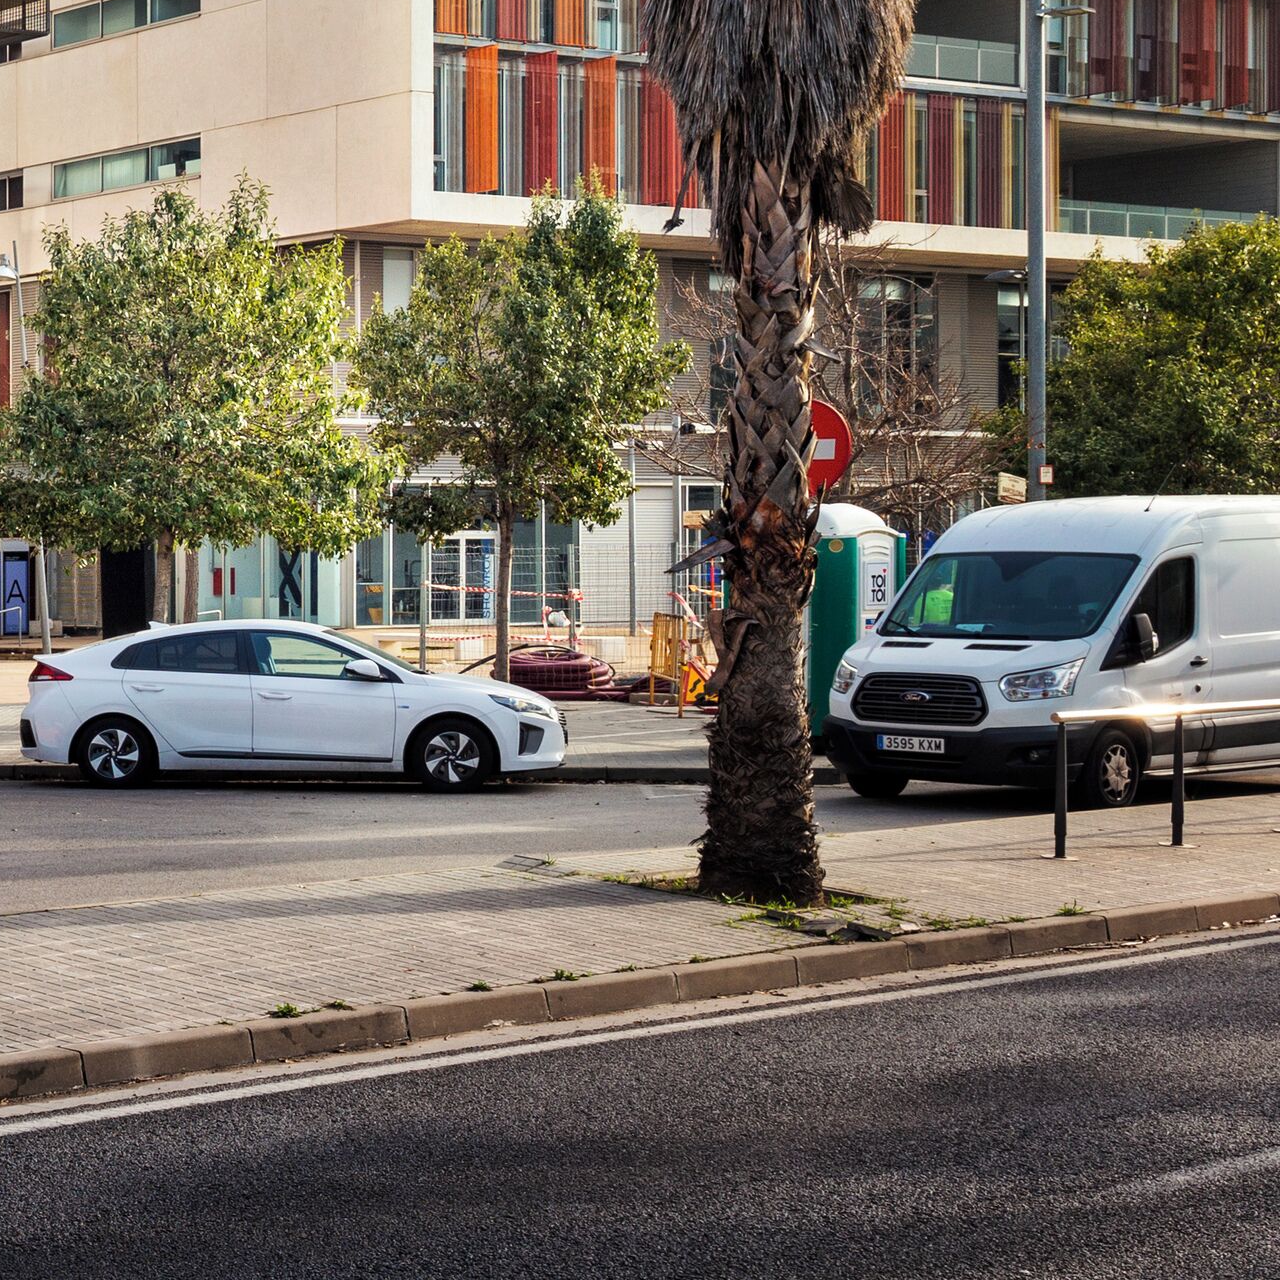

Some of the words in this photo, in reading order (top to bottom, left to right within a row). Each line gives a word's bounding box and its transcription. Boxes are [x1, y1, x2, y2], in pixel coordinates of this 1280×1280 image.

[871, 574, 887, 588] TOI
[6, 579, 25, 603] A
[871, 589, 886, 602] TOI
[886, 737, 915, 750] 3595
[918, 739, 942, 751] KXM
